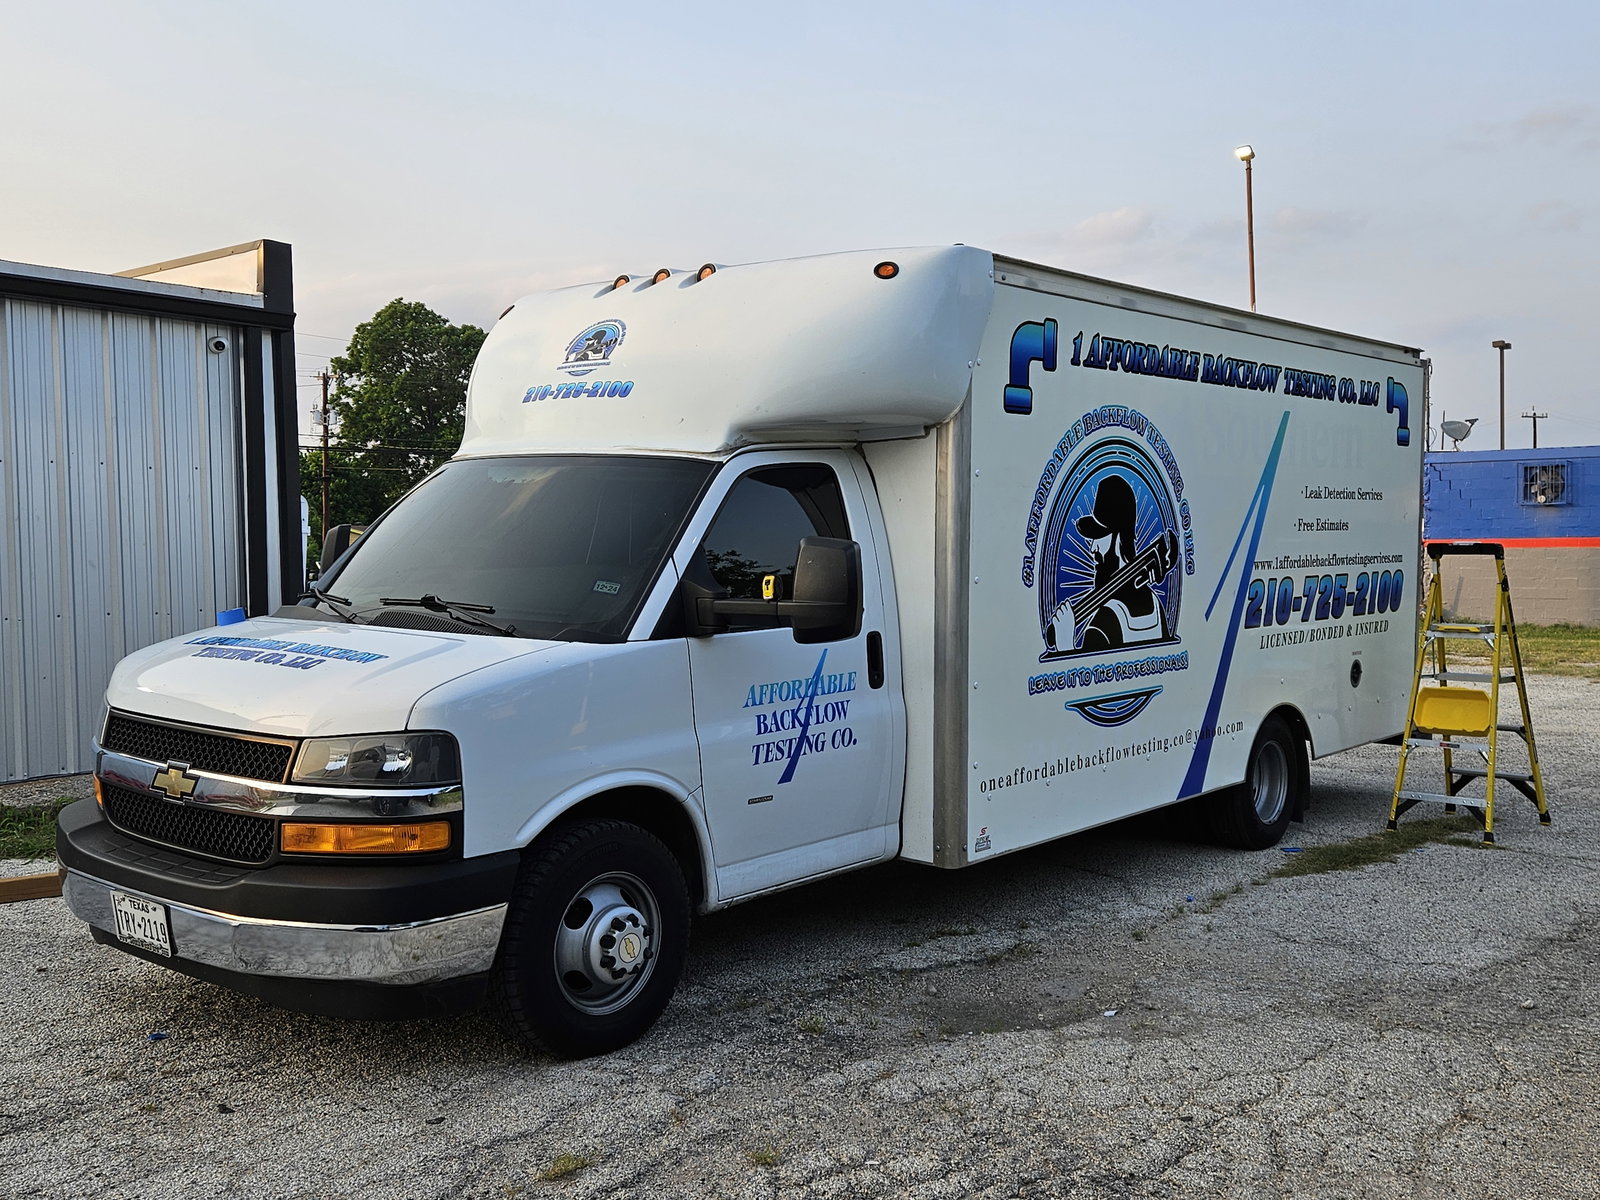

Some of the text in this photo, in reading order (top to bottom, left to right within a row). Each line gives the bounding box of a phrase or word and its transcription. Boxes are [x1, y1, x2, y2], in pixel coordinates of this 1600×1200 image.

[1071, 331, 1380, 406] 1 AFFORDABLE BACKFLOW TESTING CO. LLC
[522, 381, 634, 403] 210-725-2100
[1025, 420, 1084, 557] AFFORDABLE
[1082, 405, 1148, 436] BACKFLOW
[1305, 486, 1383, 501] Leak Detection Services
[1297, 518, 1349, 532] Free Estimates
[1253, 552, 1403, 571] www.1affordablebackflowtestingservices.com
[1244, 569, 1404, 629] 210-725-2100
[1259, 620, 1389, 650] LICENSED/BONDED & INSURED
[191, 647, 264, 662] TESTING
[279, 656, 327, 670] LLC
[1028, 650, 1189, 695] LEAVE IT TO THE PROFESSIONALS!
[831, 727, 858, 750] CO.
[129, 899, 149, 913] TEXAS
